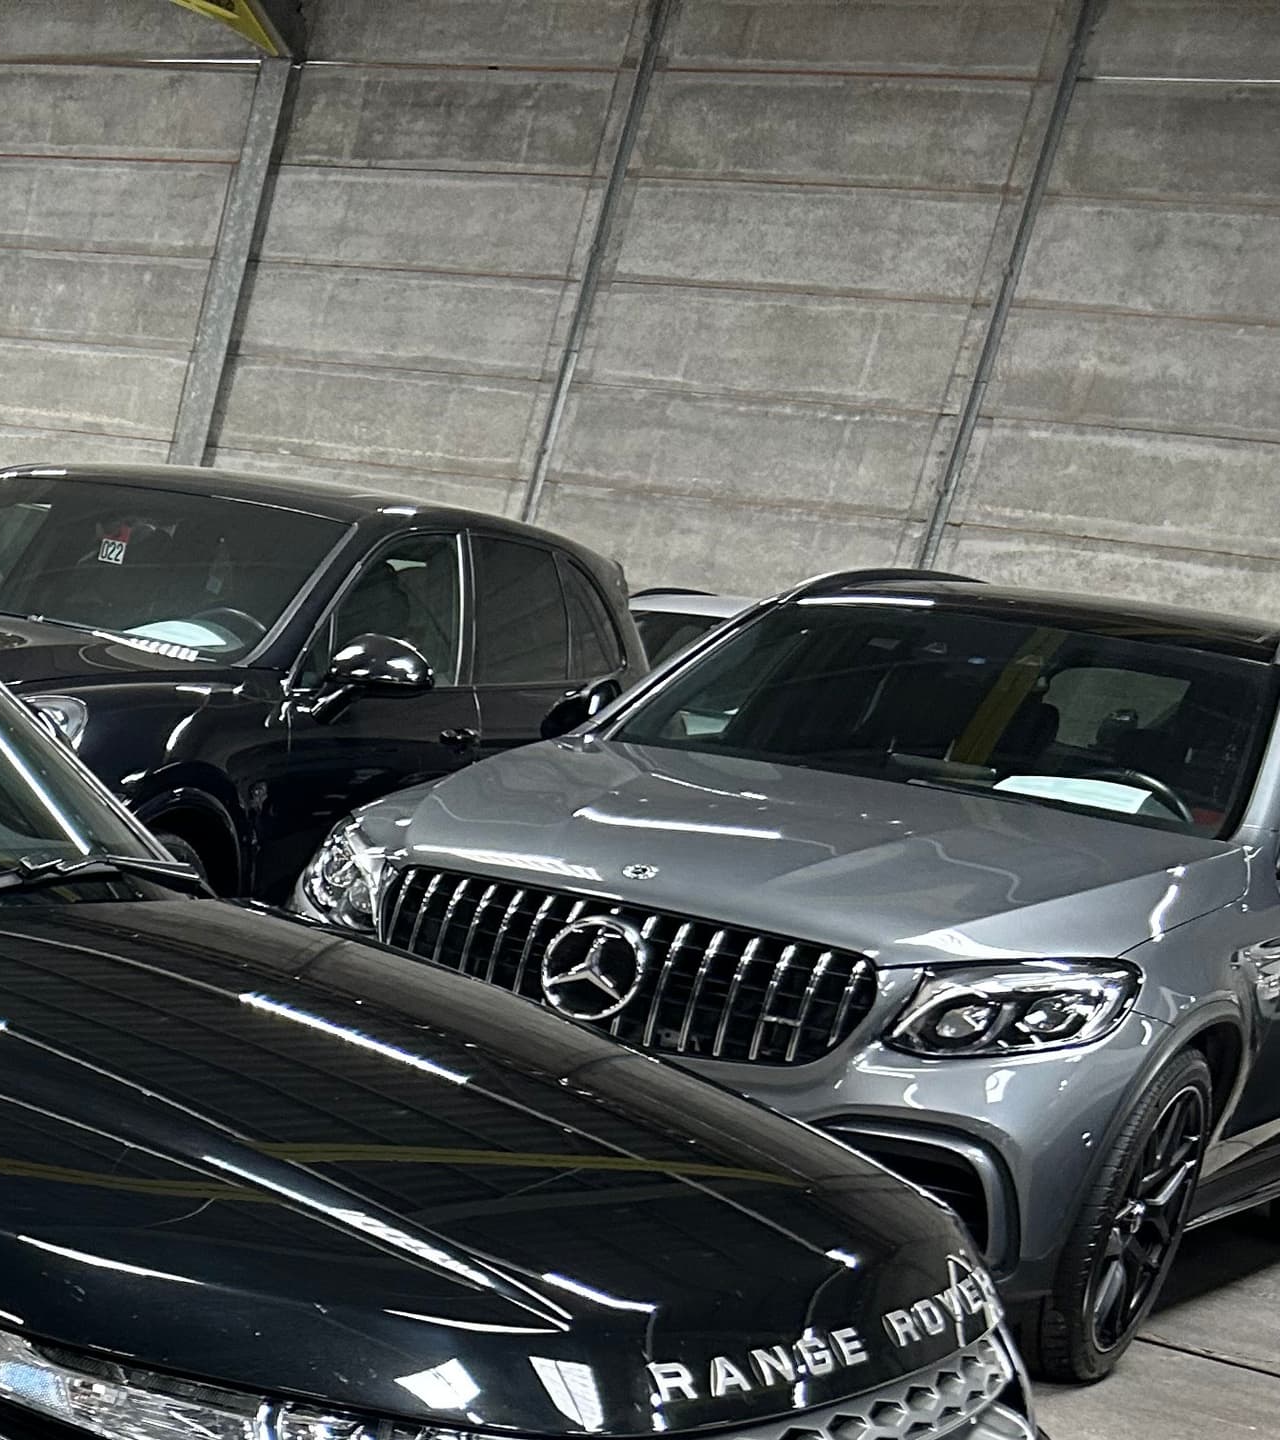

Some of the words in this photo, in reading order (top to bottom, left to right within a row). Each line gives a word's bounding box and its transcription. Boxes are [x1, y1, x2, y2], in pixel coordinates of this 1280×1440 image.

[101, 541, 123, 562] 022
[648, 1326, 869, 1402] RANGE
[882, 1266, 1000, 1347] ROVER
